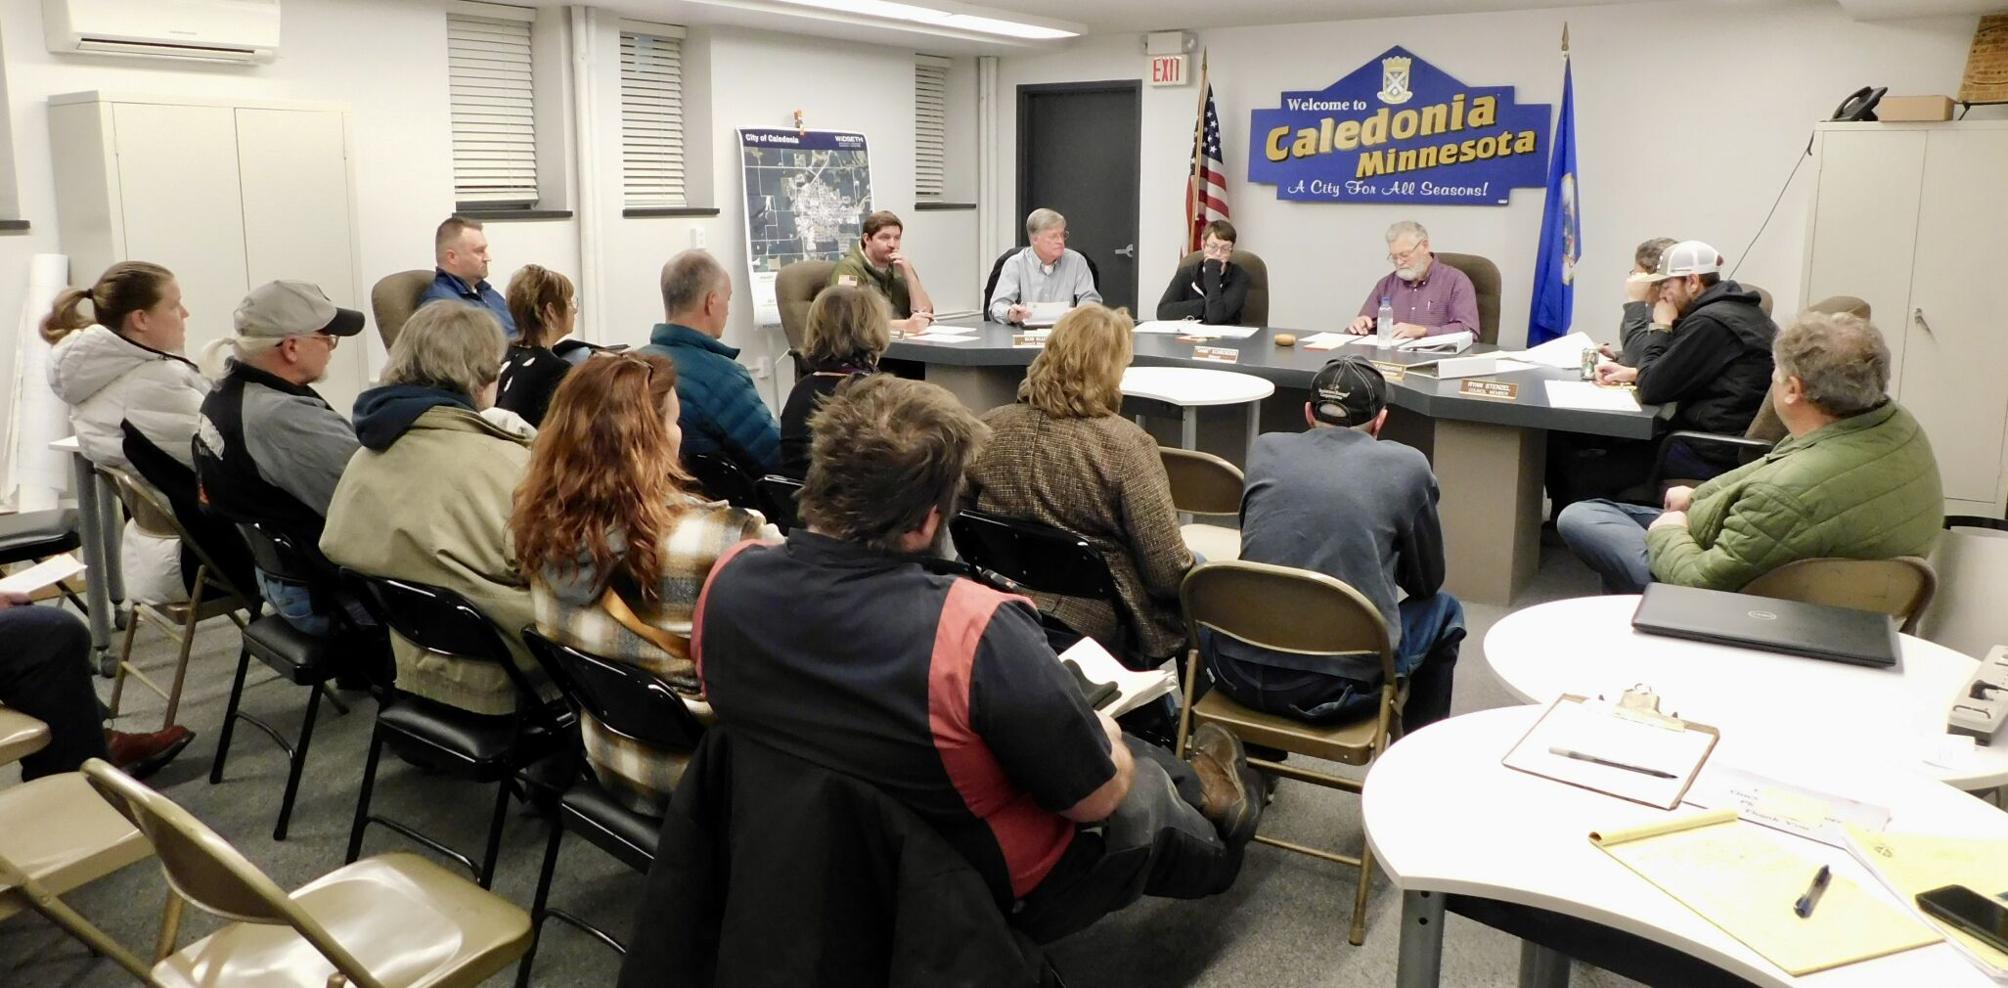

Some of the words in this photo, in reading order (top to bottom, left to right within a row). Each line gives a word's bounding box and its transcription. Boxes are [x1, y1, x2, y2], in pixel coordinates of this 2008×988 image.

[1153, 58, 1181, 82] EXIT
[1287, 98, 1350, 111] Welcome
[1353, 100, 1367, 111] to
[1265, 93, 1497, 162] Caledonia
[745, 133, 759, 143] City
[768, 134, 799, 144] Caledonia
[1355, 130, 1536, 178] Minnesota
[1287, 180, 1305, 194] A
[1311, 179, 1340, 197] City
[1346, 180, 1376, 196] For
[1381, 181, 1415, 196] All
[1420, 182, 1488, 197] Seasons!
